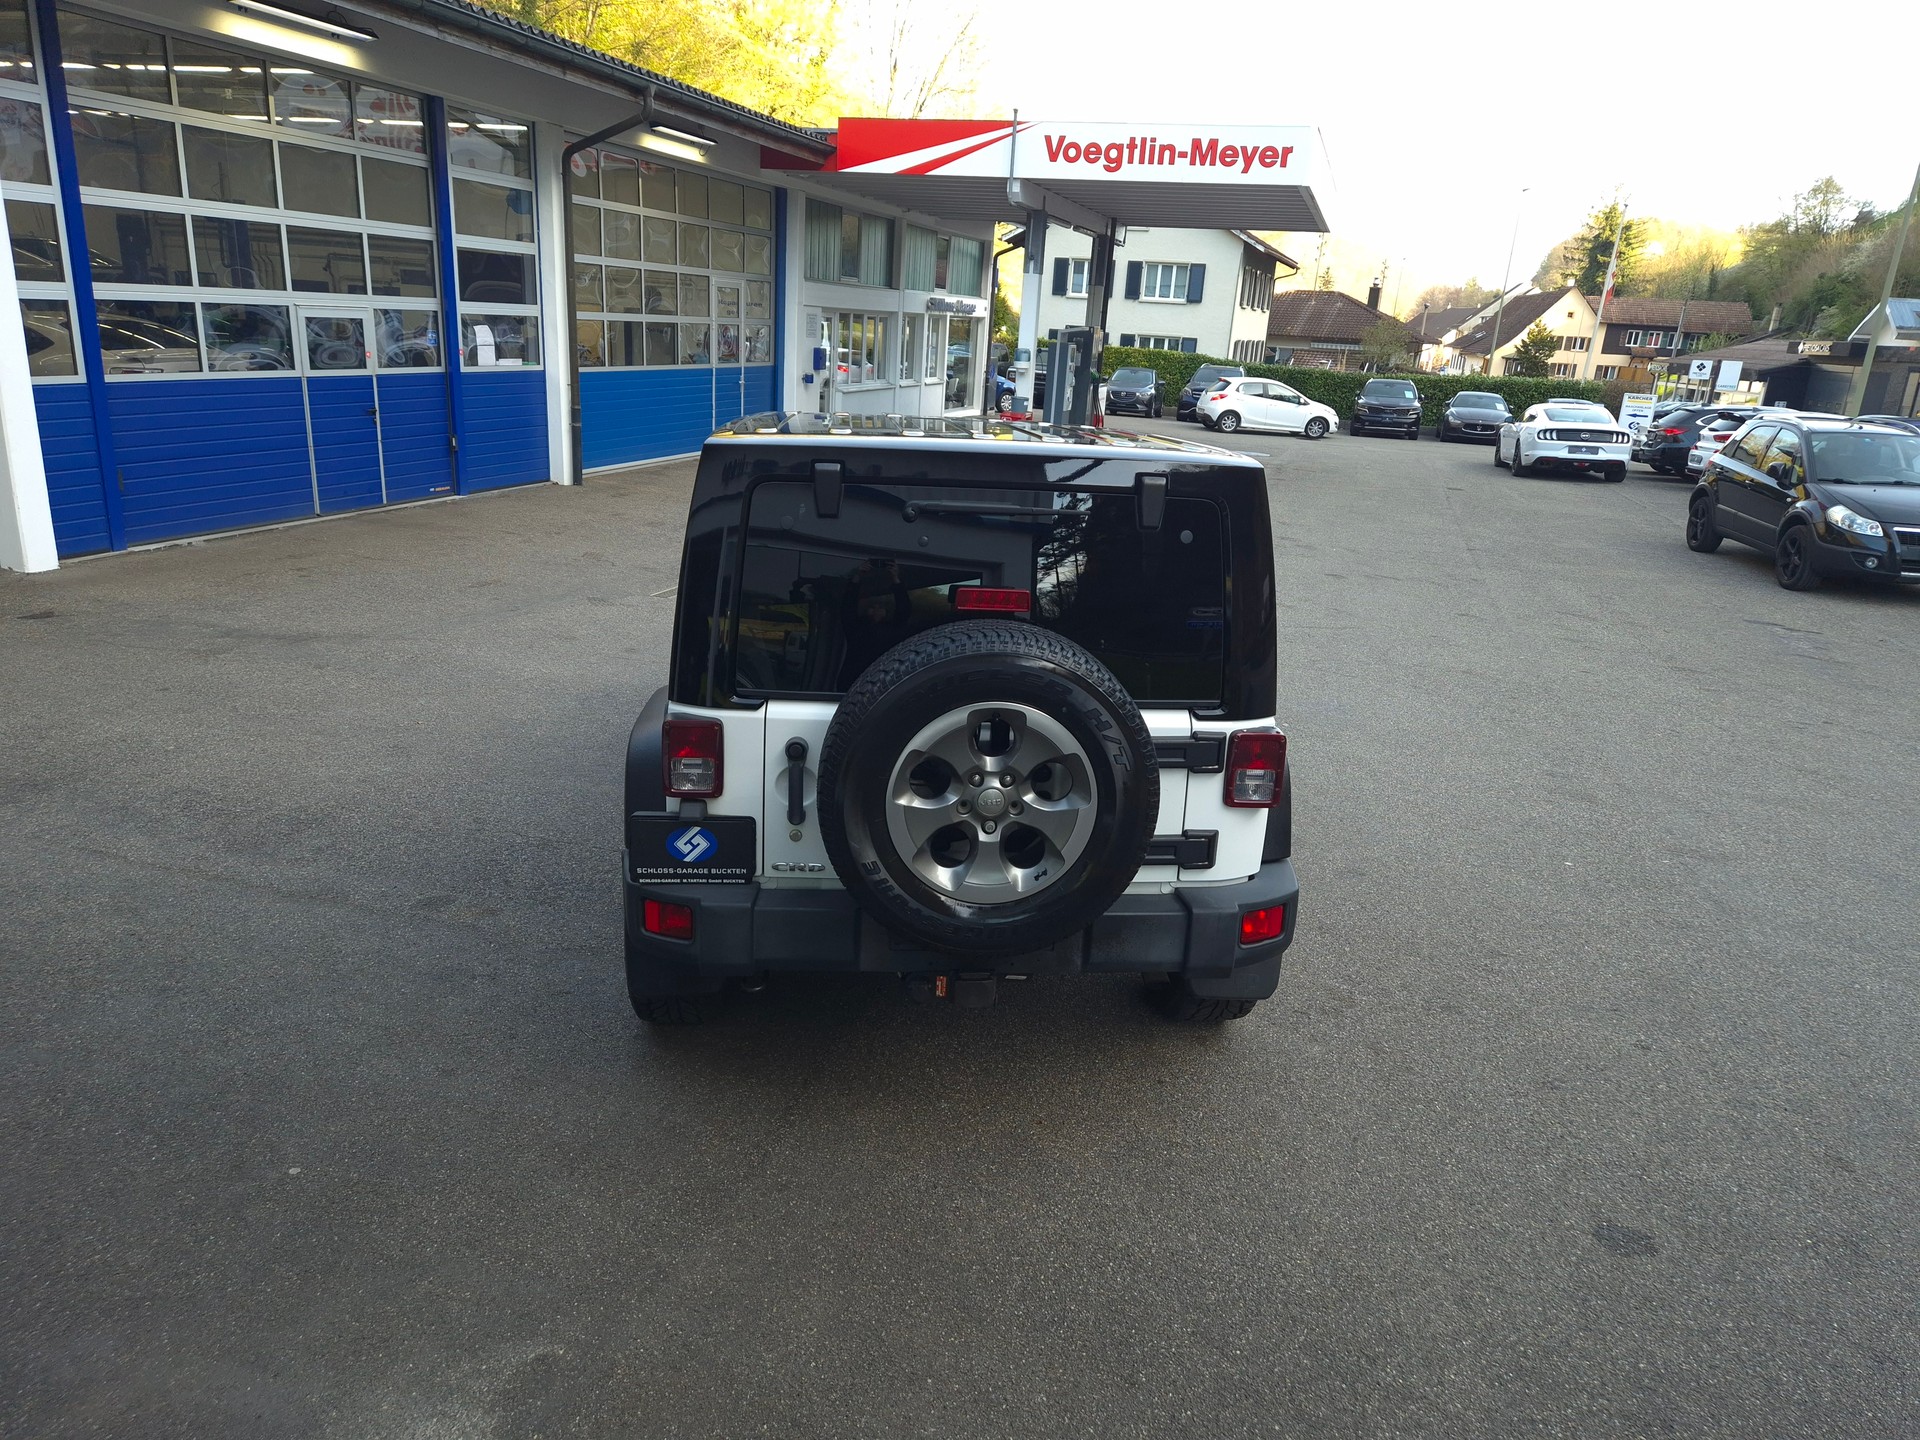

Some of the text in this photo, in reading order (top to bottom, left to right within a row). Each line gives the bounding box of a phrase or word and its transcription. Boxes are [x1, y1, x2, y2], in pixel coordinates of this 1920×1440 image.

[1044, 135, 1294, 174] Voegtlin-Meyer
[1083, 706, 1131, 772] H/T
[711, 867, 747, 875] BUCKTEN
[772, 861, 826, 873] CRD
